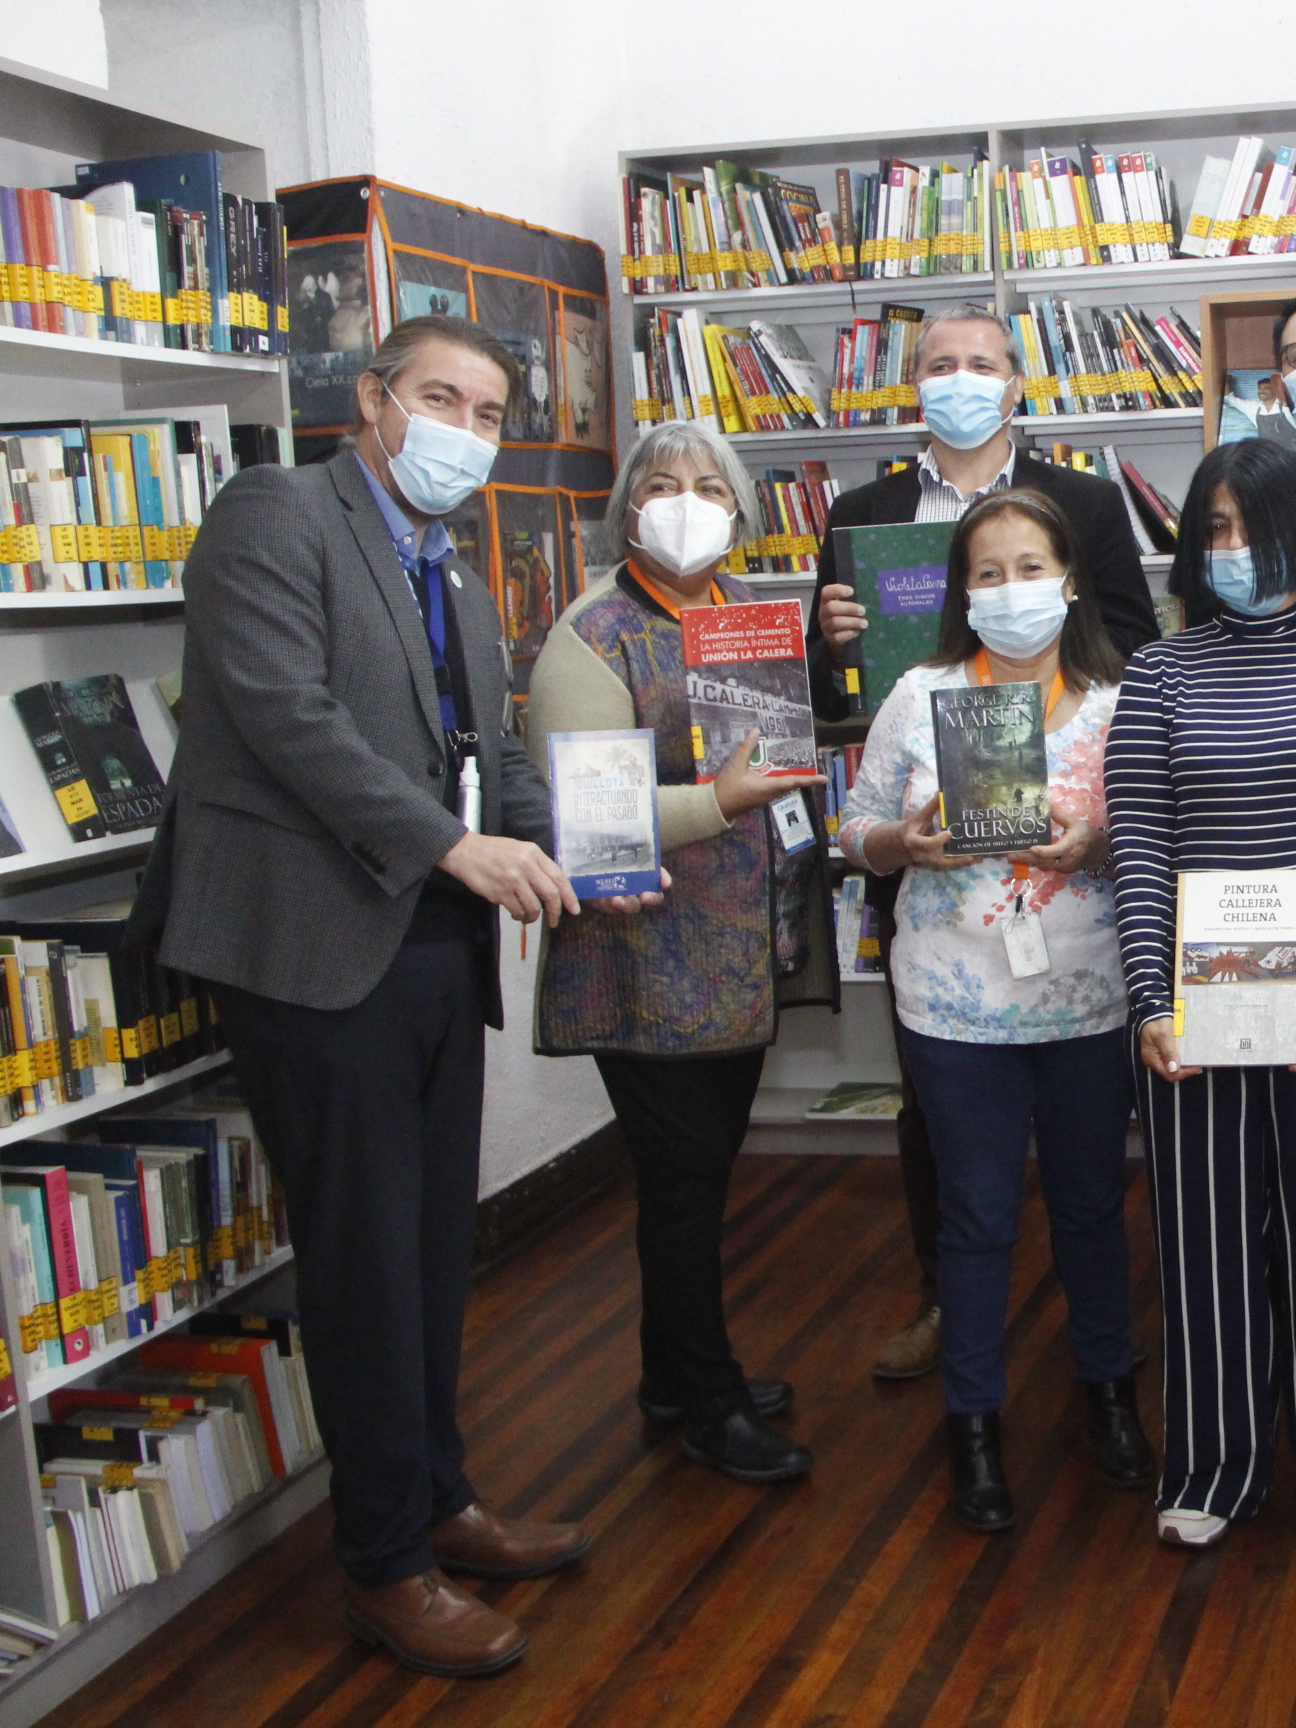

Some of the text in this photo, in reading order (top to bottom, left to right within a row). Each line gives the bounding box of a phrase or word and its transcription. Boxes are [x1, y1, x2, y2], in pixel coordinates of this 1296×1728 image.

[228, 206, 238, 258] GREY
[700, 631, 744, 640] CAMPEONES
[757, 628, 791, 636] CEMENTO
[700, 637, 792, 651] LA HISTORIA ÍNTIMA DE
[701, 648, 794, 662] UNIÓN LA CALERA
[943, 694, 1000, 709] GEORGE
[574, 789, 638, 807] INTERACTUANDO
[102, 796, 163, 823] ESPADA
[575, 804, 638, 823] CON EL PASADO
[1011, 806, 1031, 817] DE
[948, 817, 1047, 840] CUERVOS
[1223, 884, 1279, 895] PINTURA
[1218, 898, 1282, 908] CALLEJERA
[1223, 912, 1277, 922] CHILENA
